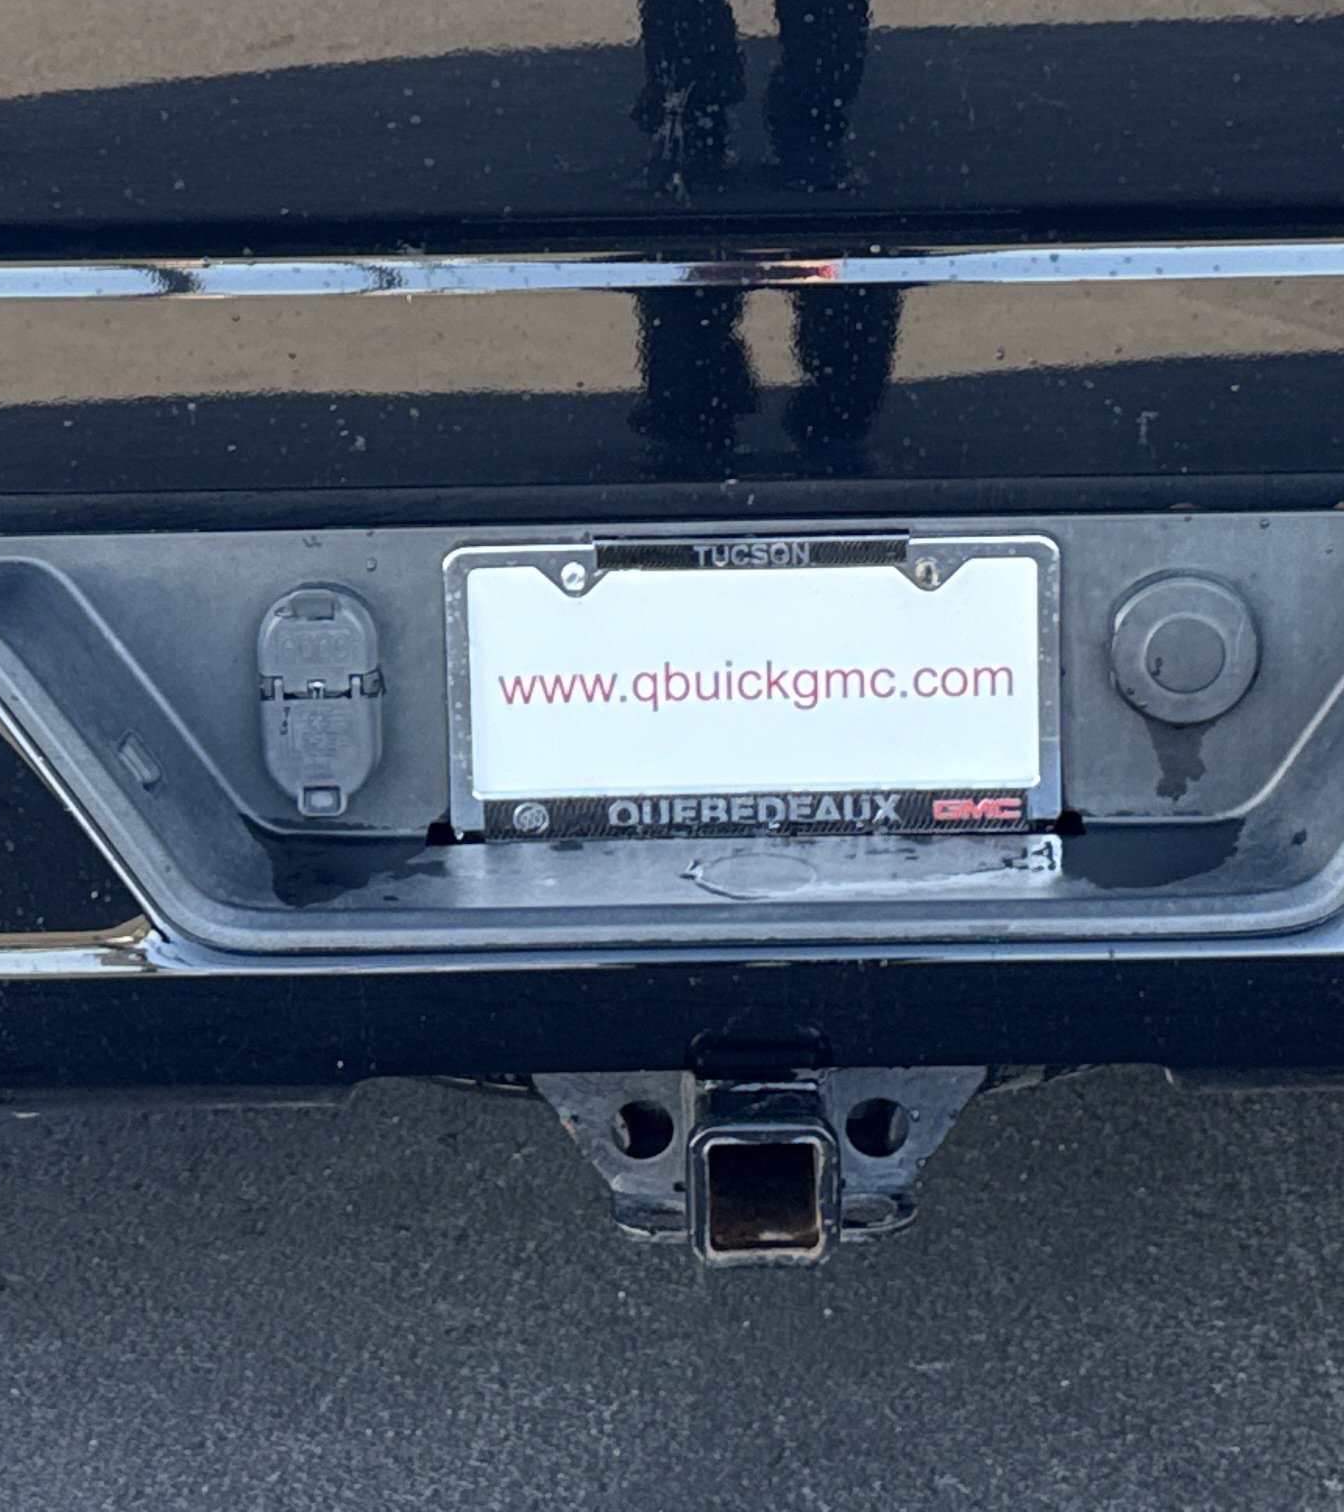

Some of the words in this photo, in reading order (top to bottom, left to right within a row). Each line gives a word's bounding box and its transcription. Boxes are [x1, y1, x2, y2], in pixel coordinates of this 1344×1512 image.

[693, 543, 810, 568] TUCSON
[498, 660, 1014, 710] www.qbuickgmc.com
[607, 793, 902, 826] QUEBEDEAUX
[932, 796, 1022, 821] GMC
